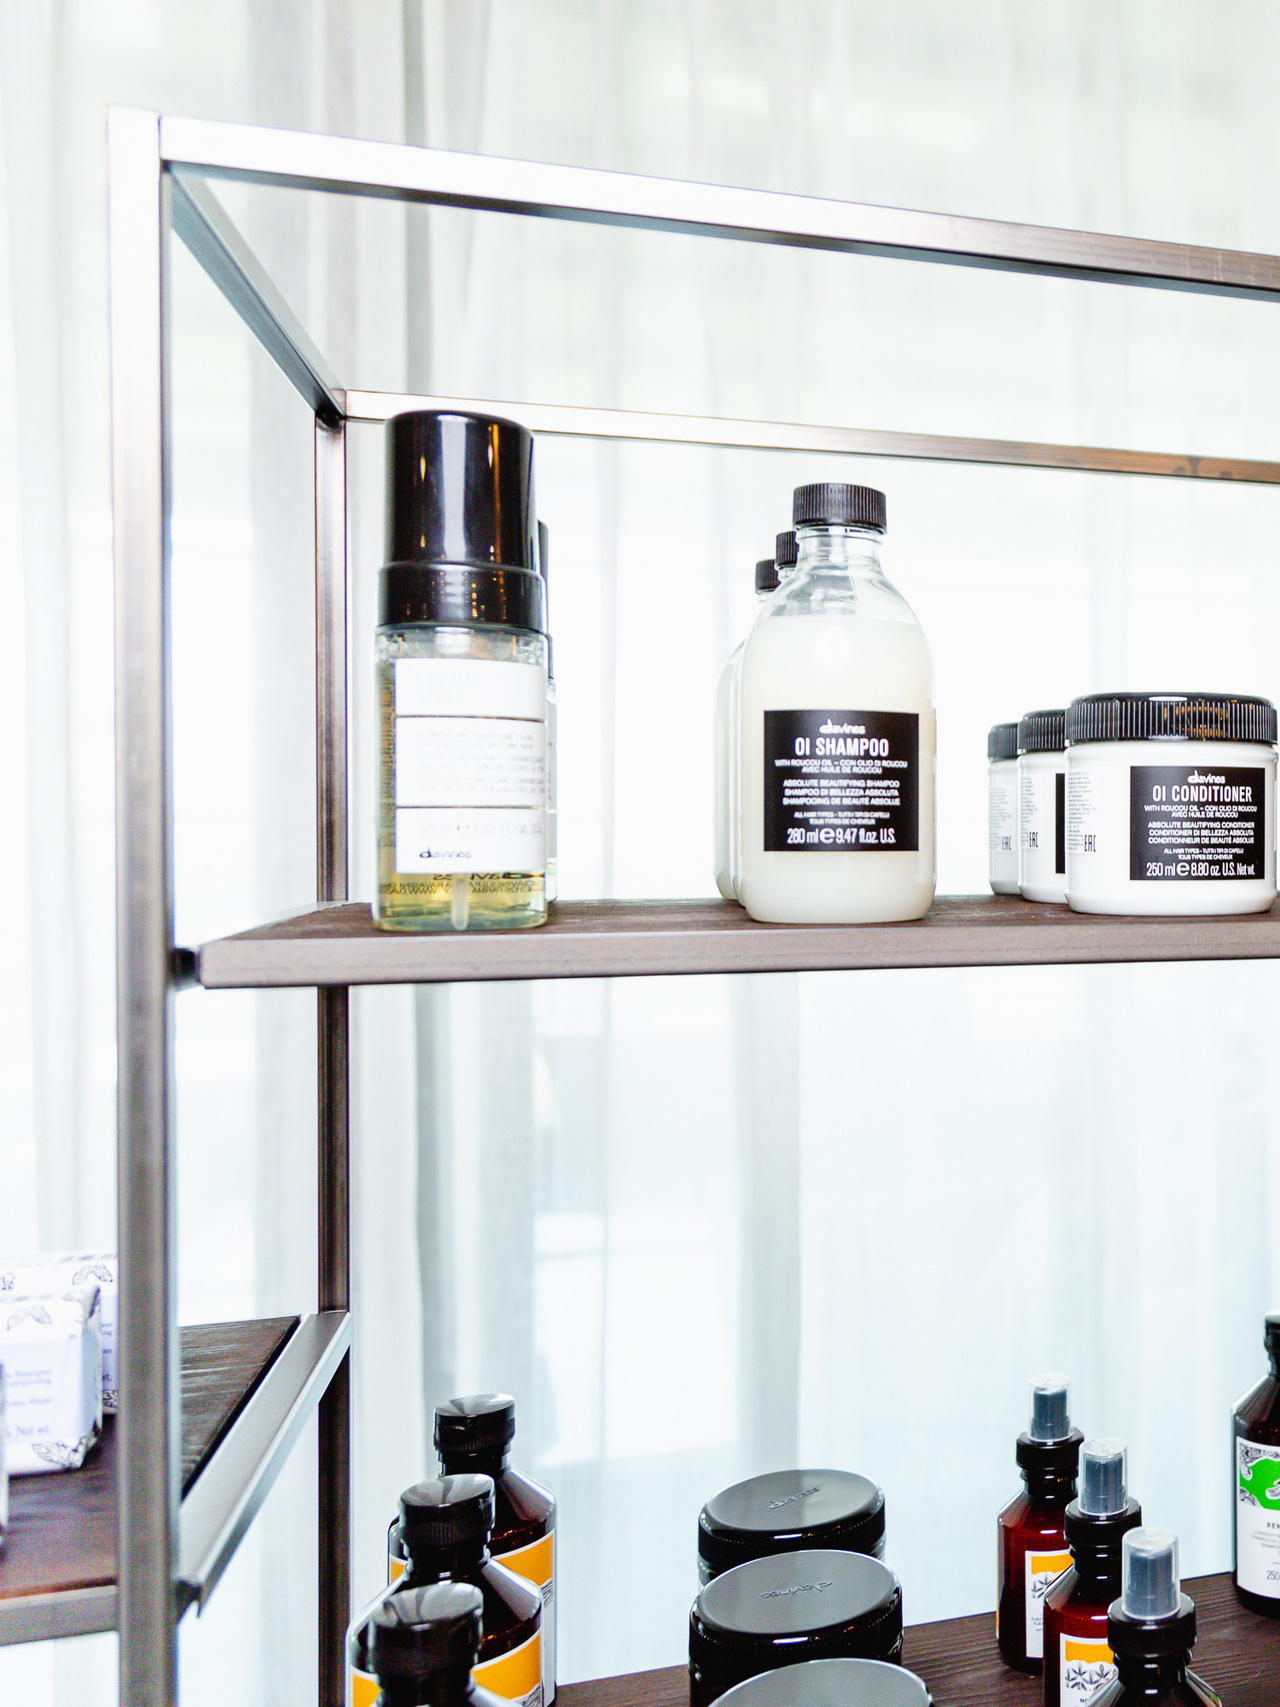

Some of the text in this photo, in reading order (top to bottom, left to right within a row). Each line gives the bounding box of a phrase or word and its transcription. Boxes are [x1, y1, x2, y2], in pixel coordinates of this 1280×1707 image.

[819, 718, 866, 735] davines
[795, 737, 889, 757] OI SHAMPOO
[783, 779, 900, 788] ABSOLUTE BEAUTIFYING SHAMPOO
[1187, 769, 1226, 784] davines
[784, 788, 899, 796] SHAMPOO DI BELLEZZA ASSOLUTA
[1152, 785, 1252, 802] OI CONDITIONER
[782, 797, 830, 805] SHAMPOOING
[831, 797, 841, 805] DE
[870, 797, 900, 806] ABSOLUE
[787, 828, 805, 844] 280
[806, 829, 819, 844] ml
[835, 828, 857, 844] 9.47
[880, 828, 897, 844] U.S.
[419, 847, 472, 859] davines
[1146, 862, 1164, 876] 250
[1164, 862, 1176, 876] ml
[1267, 1570, 1280, 1581] 250
